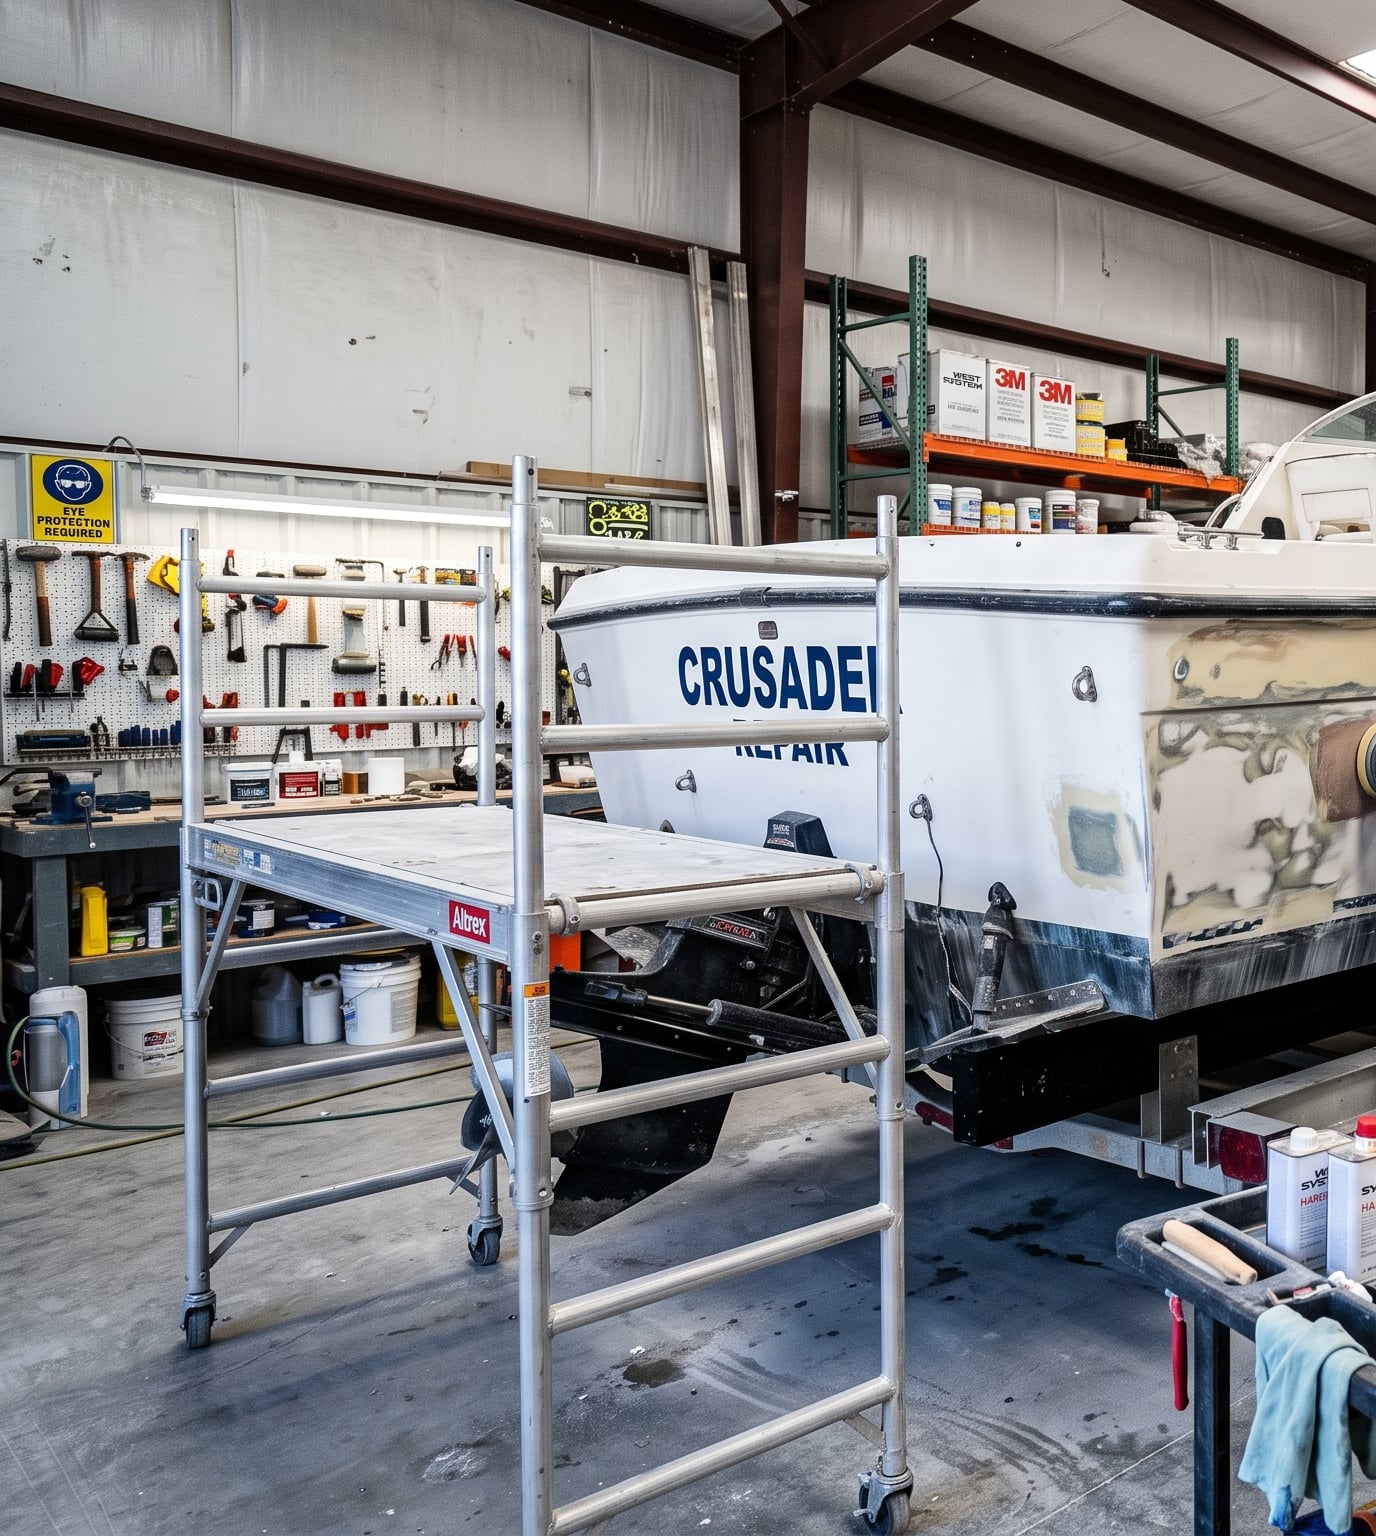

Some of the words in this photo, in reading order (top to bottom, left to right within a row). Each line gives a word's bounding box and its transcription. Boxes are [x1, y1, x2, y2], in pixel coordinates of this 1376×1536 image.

[953, 371, 981, 383] WEST
[995, 368, 1026, 391] 3M
[1039, 380, 1072, 405] 3M
[63, 507, 85, 517] EYE
[37, 515, 110, 528] PROTECTION
[44, 527, 103, 538] REQUIRED
[453, 905, 487, 938] Altrex
